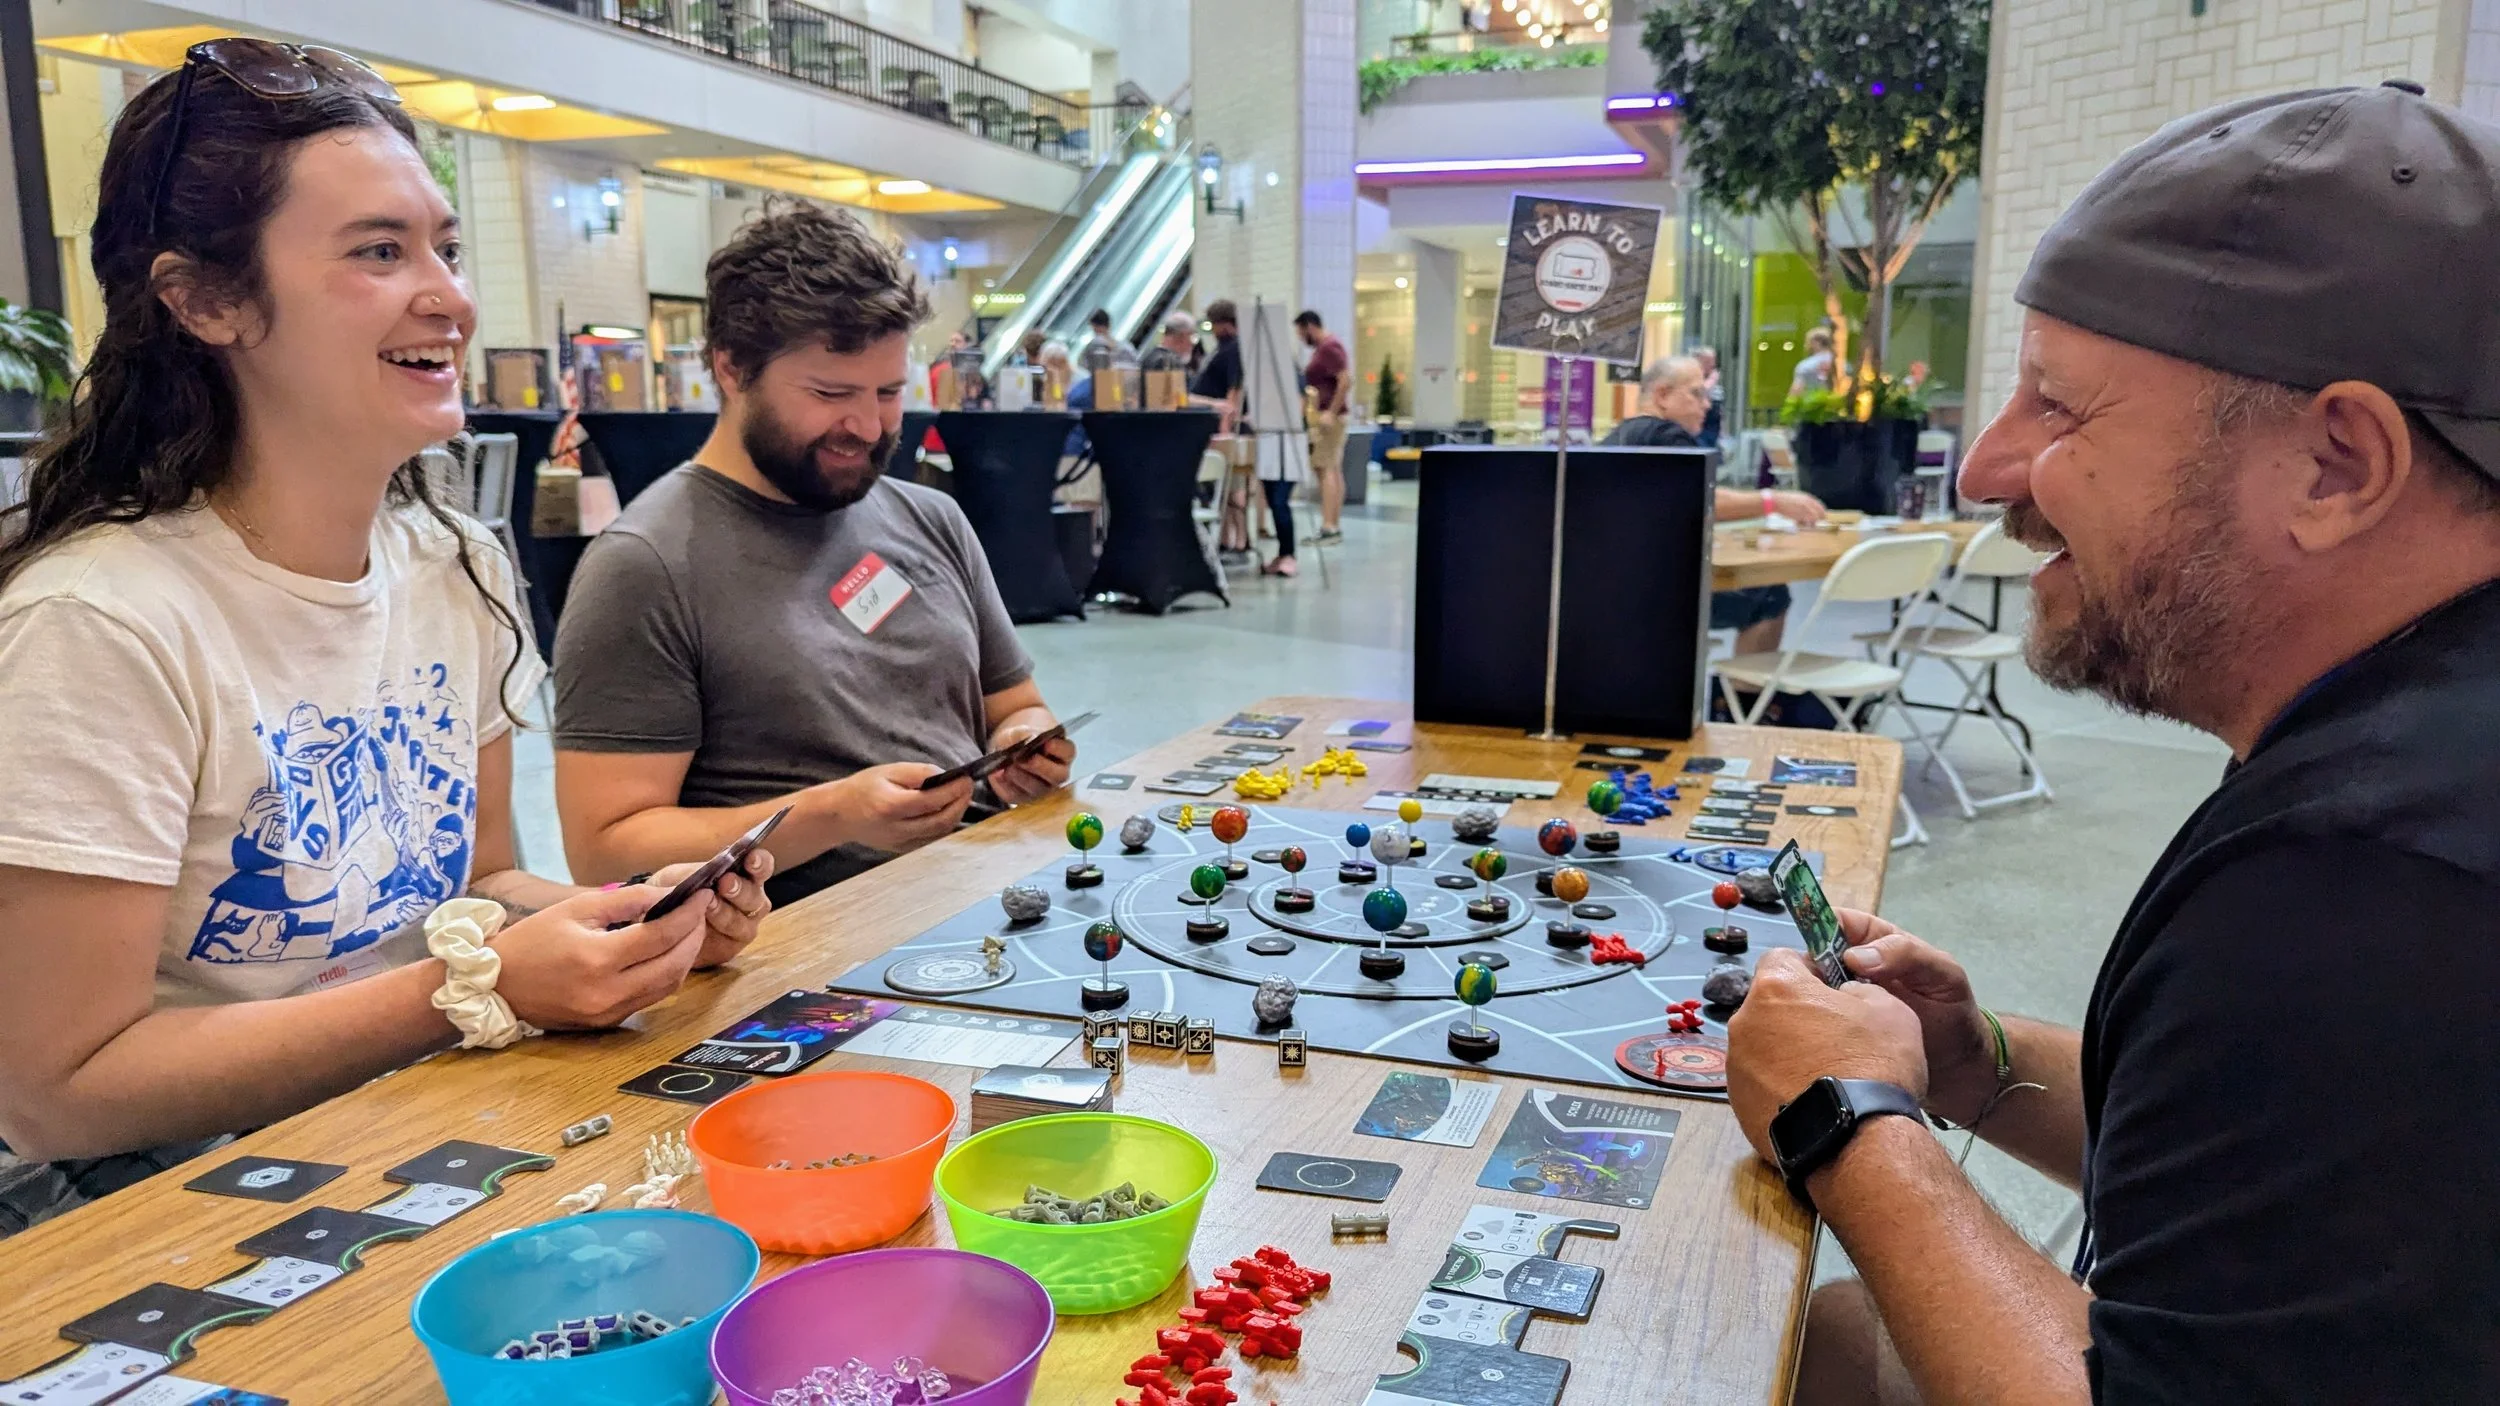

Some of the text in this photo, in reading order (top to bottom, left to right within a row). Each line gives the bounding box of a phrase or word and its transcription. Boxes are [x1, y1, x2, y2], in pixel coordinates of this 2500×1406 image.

[1522, 212, 1634, 254] LEARN TO
[1535, 312, 1596, 340] PLAY
[841, 567, 869, 594] HELLO
[858, 585, 879, 615] Sid
